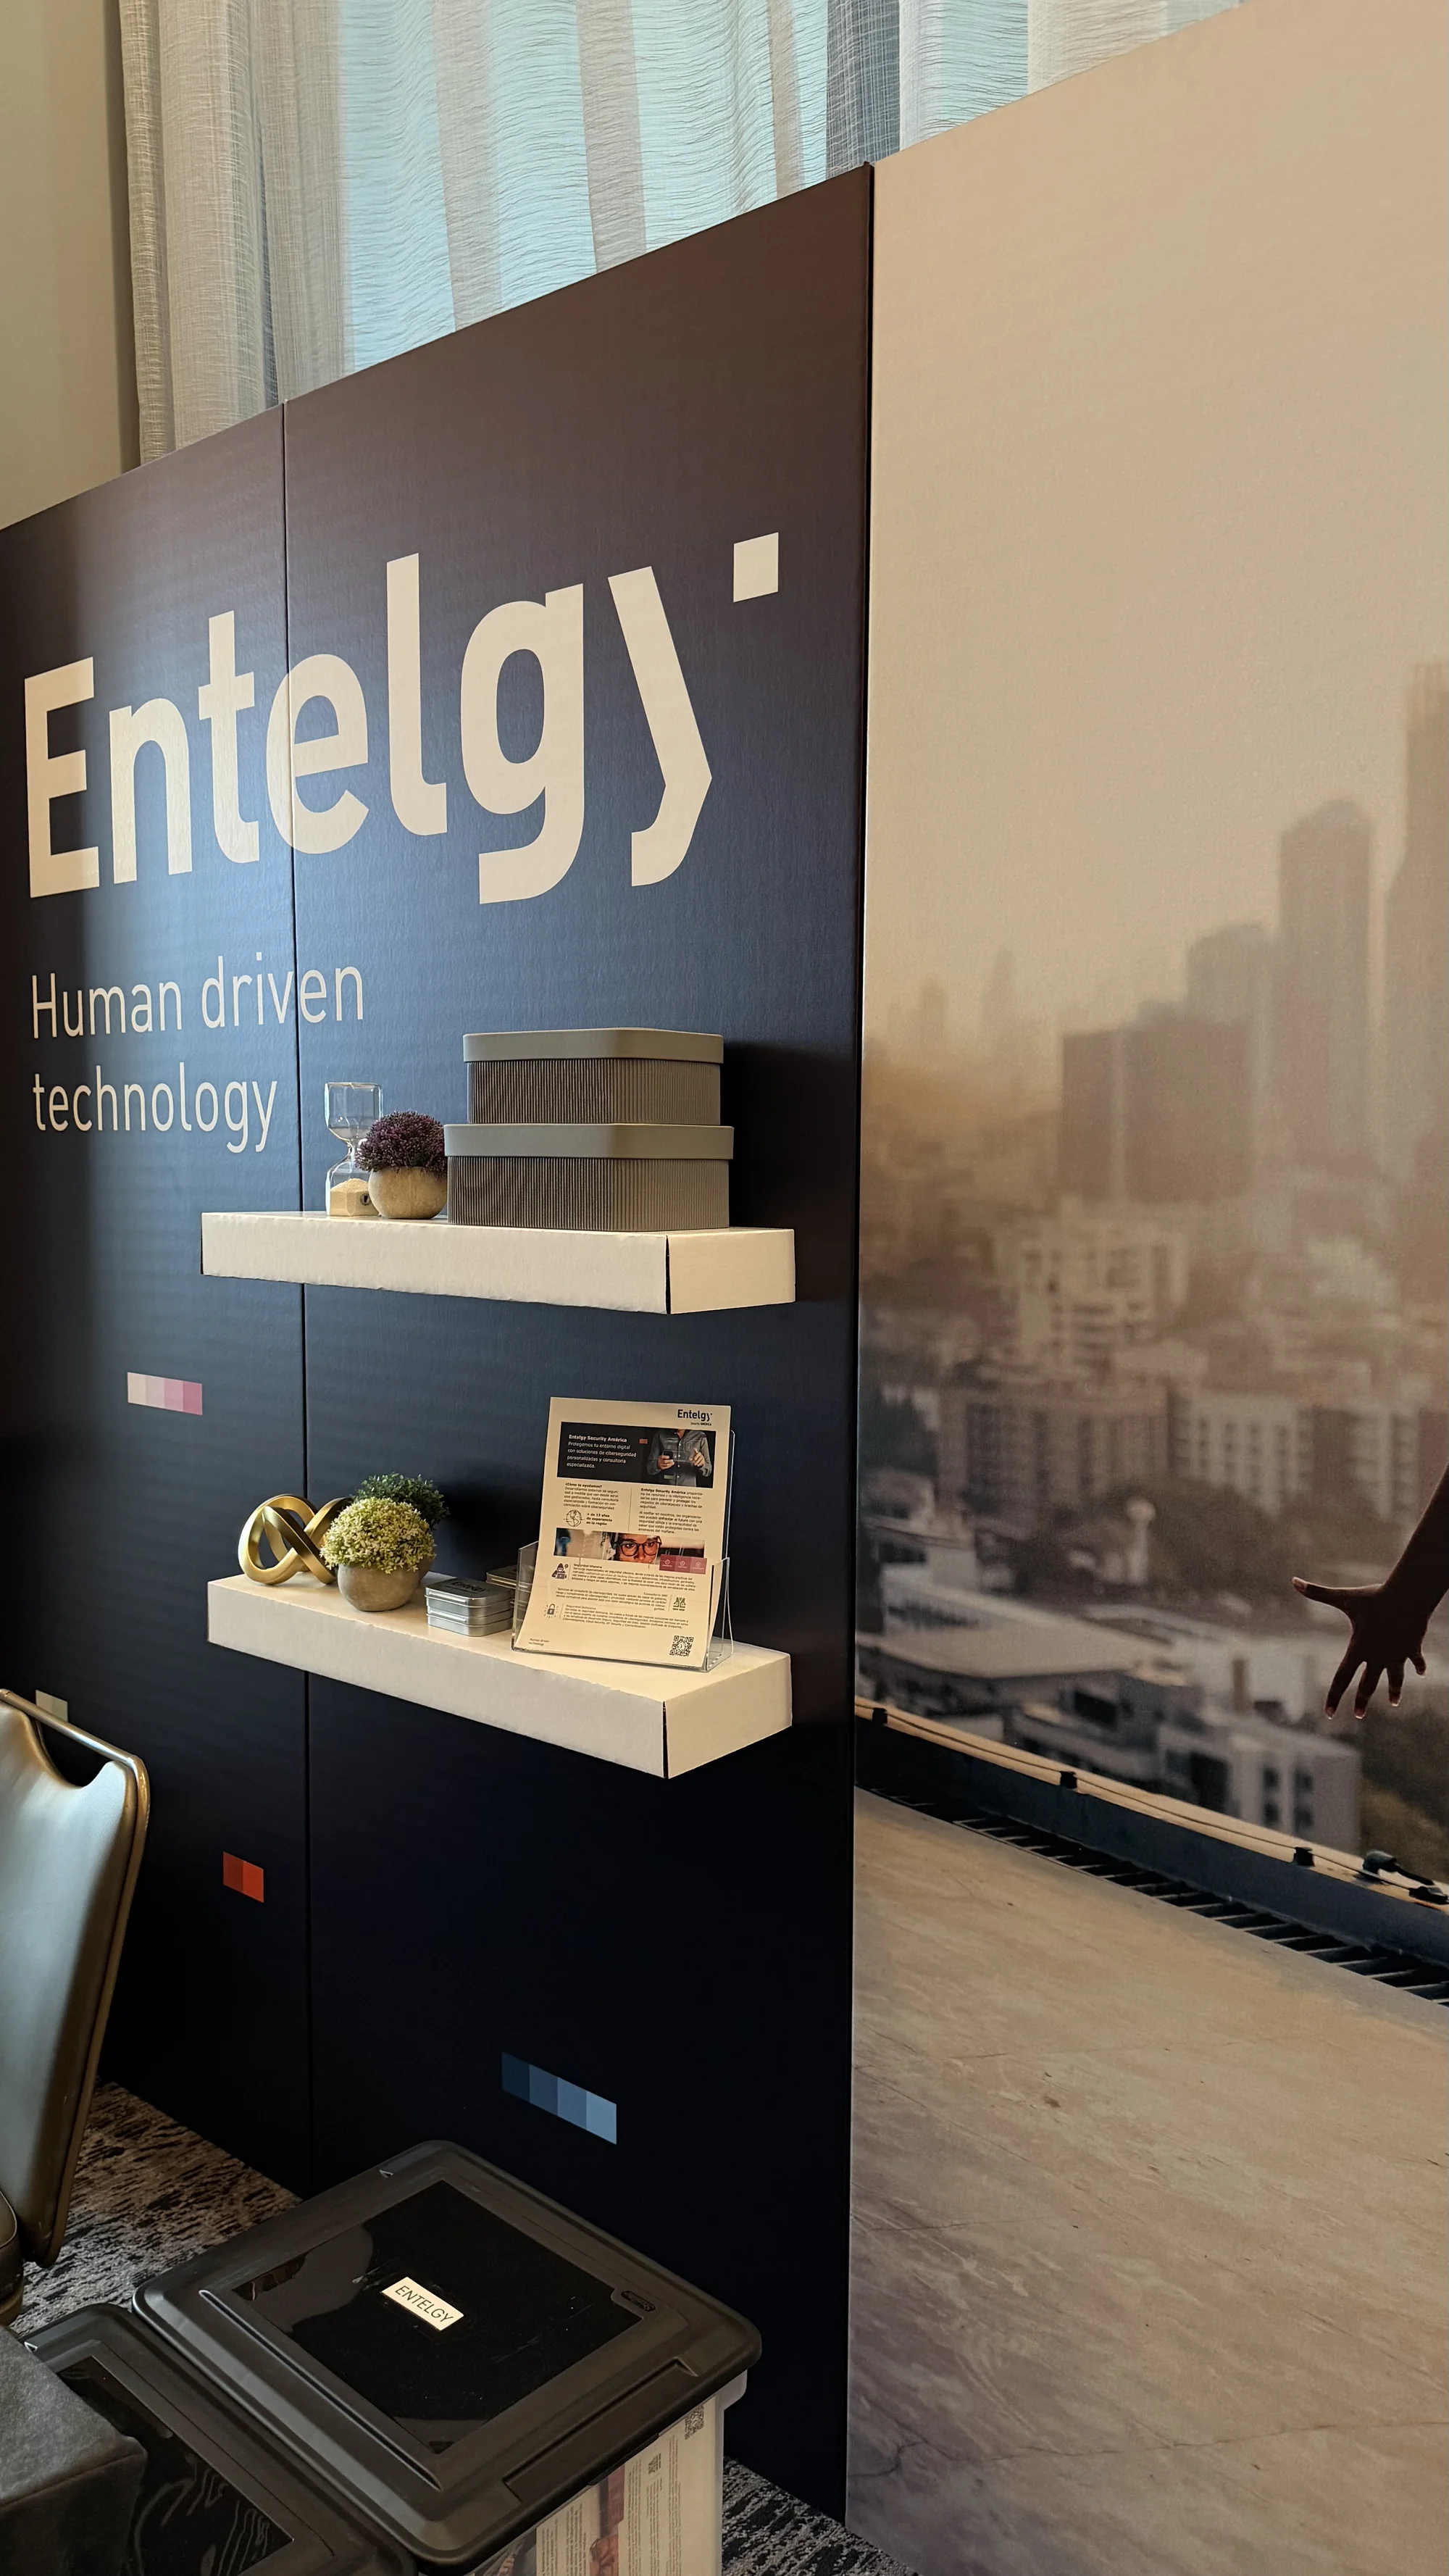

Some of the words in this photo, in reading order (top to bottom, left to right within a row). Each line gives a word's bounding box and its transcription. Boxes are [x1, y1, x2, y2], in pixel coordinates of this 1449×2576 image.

[25, 553, 712, 904] Entelgy
[32, 972, 183, 1039] Human
[201, 951, 364, 1029] driven
[33, 1062, 277, 1154] technology
[677, 1409, 711, 1422] Entelgy
[395, 2285, 454, 2322] ENTELGY
